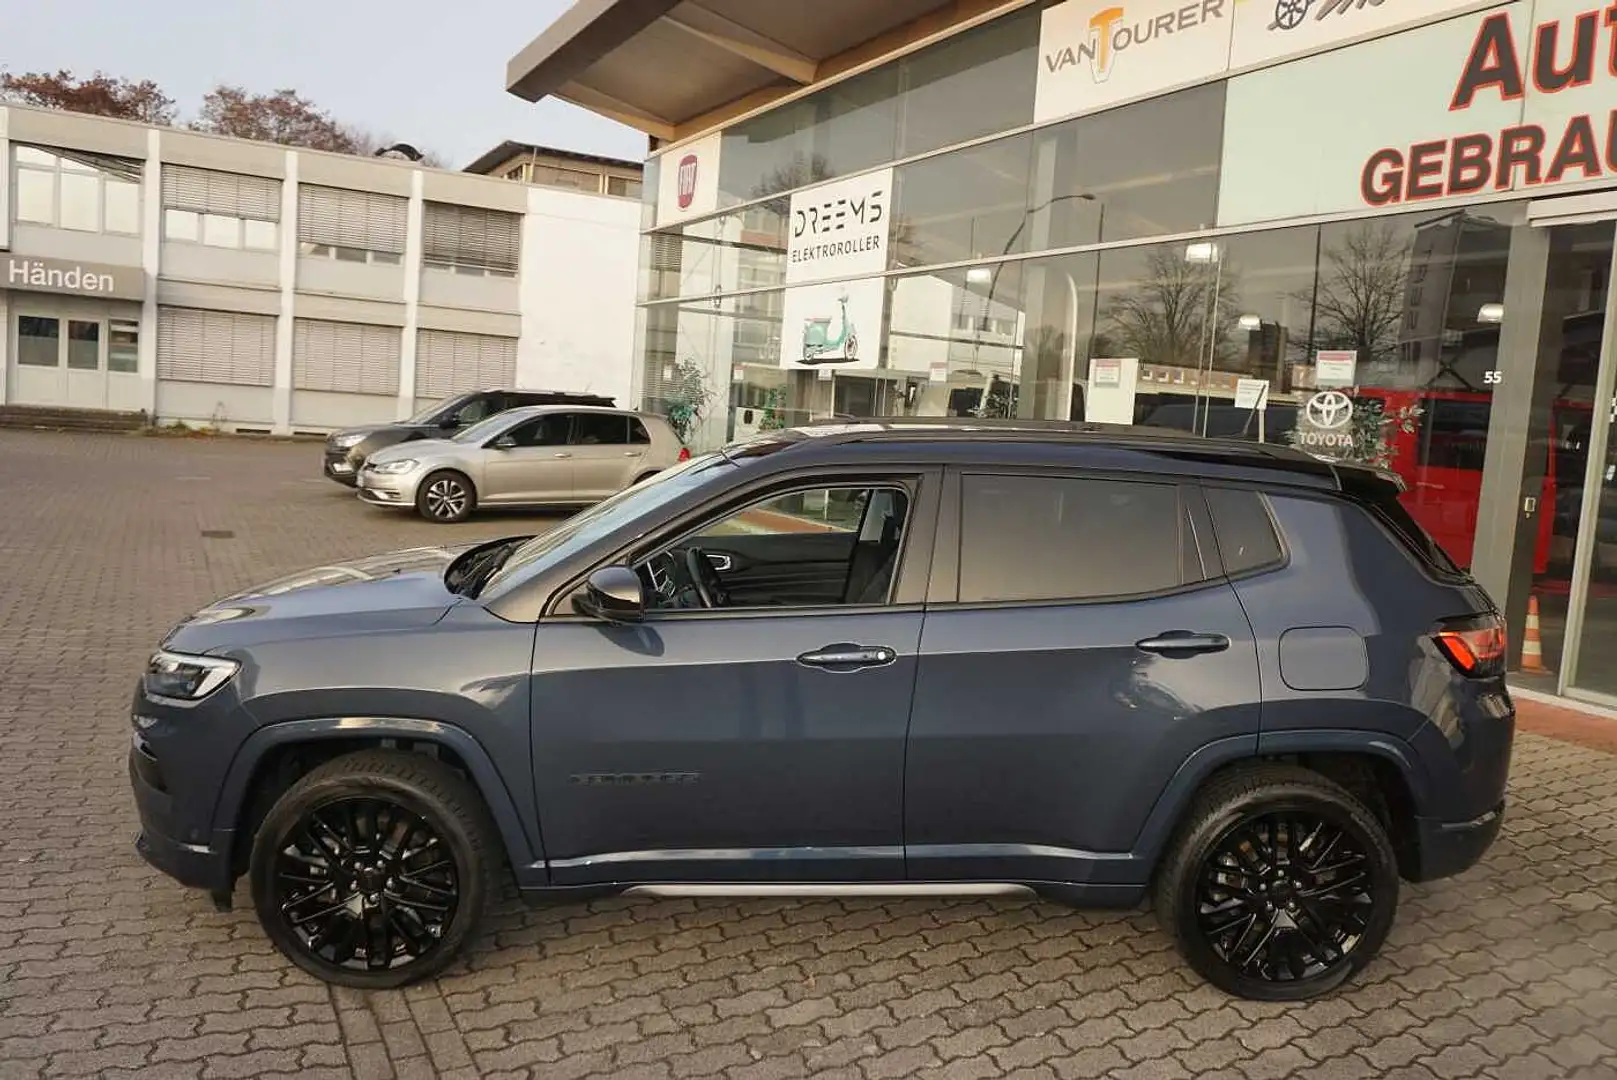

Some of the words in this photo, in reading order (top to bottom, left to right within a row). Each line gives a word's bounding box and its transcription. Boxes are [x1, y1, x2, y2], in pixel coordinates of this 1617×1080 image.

[1045, 0, 1224, 73] VANTOURER
[1361, 109, 1617, 208] GEBRA
[794, 190, 883, 238] DREEMS
[791, 235, 880, 263] ELEKTROROLLER
[9, 259, 115, 292] Händen
[1483, 371, 1503, 384] 55
[1300, 432, 1353, 447] TOYOTA
